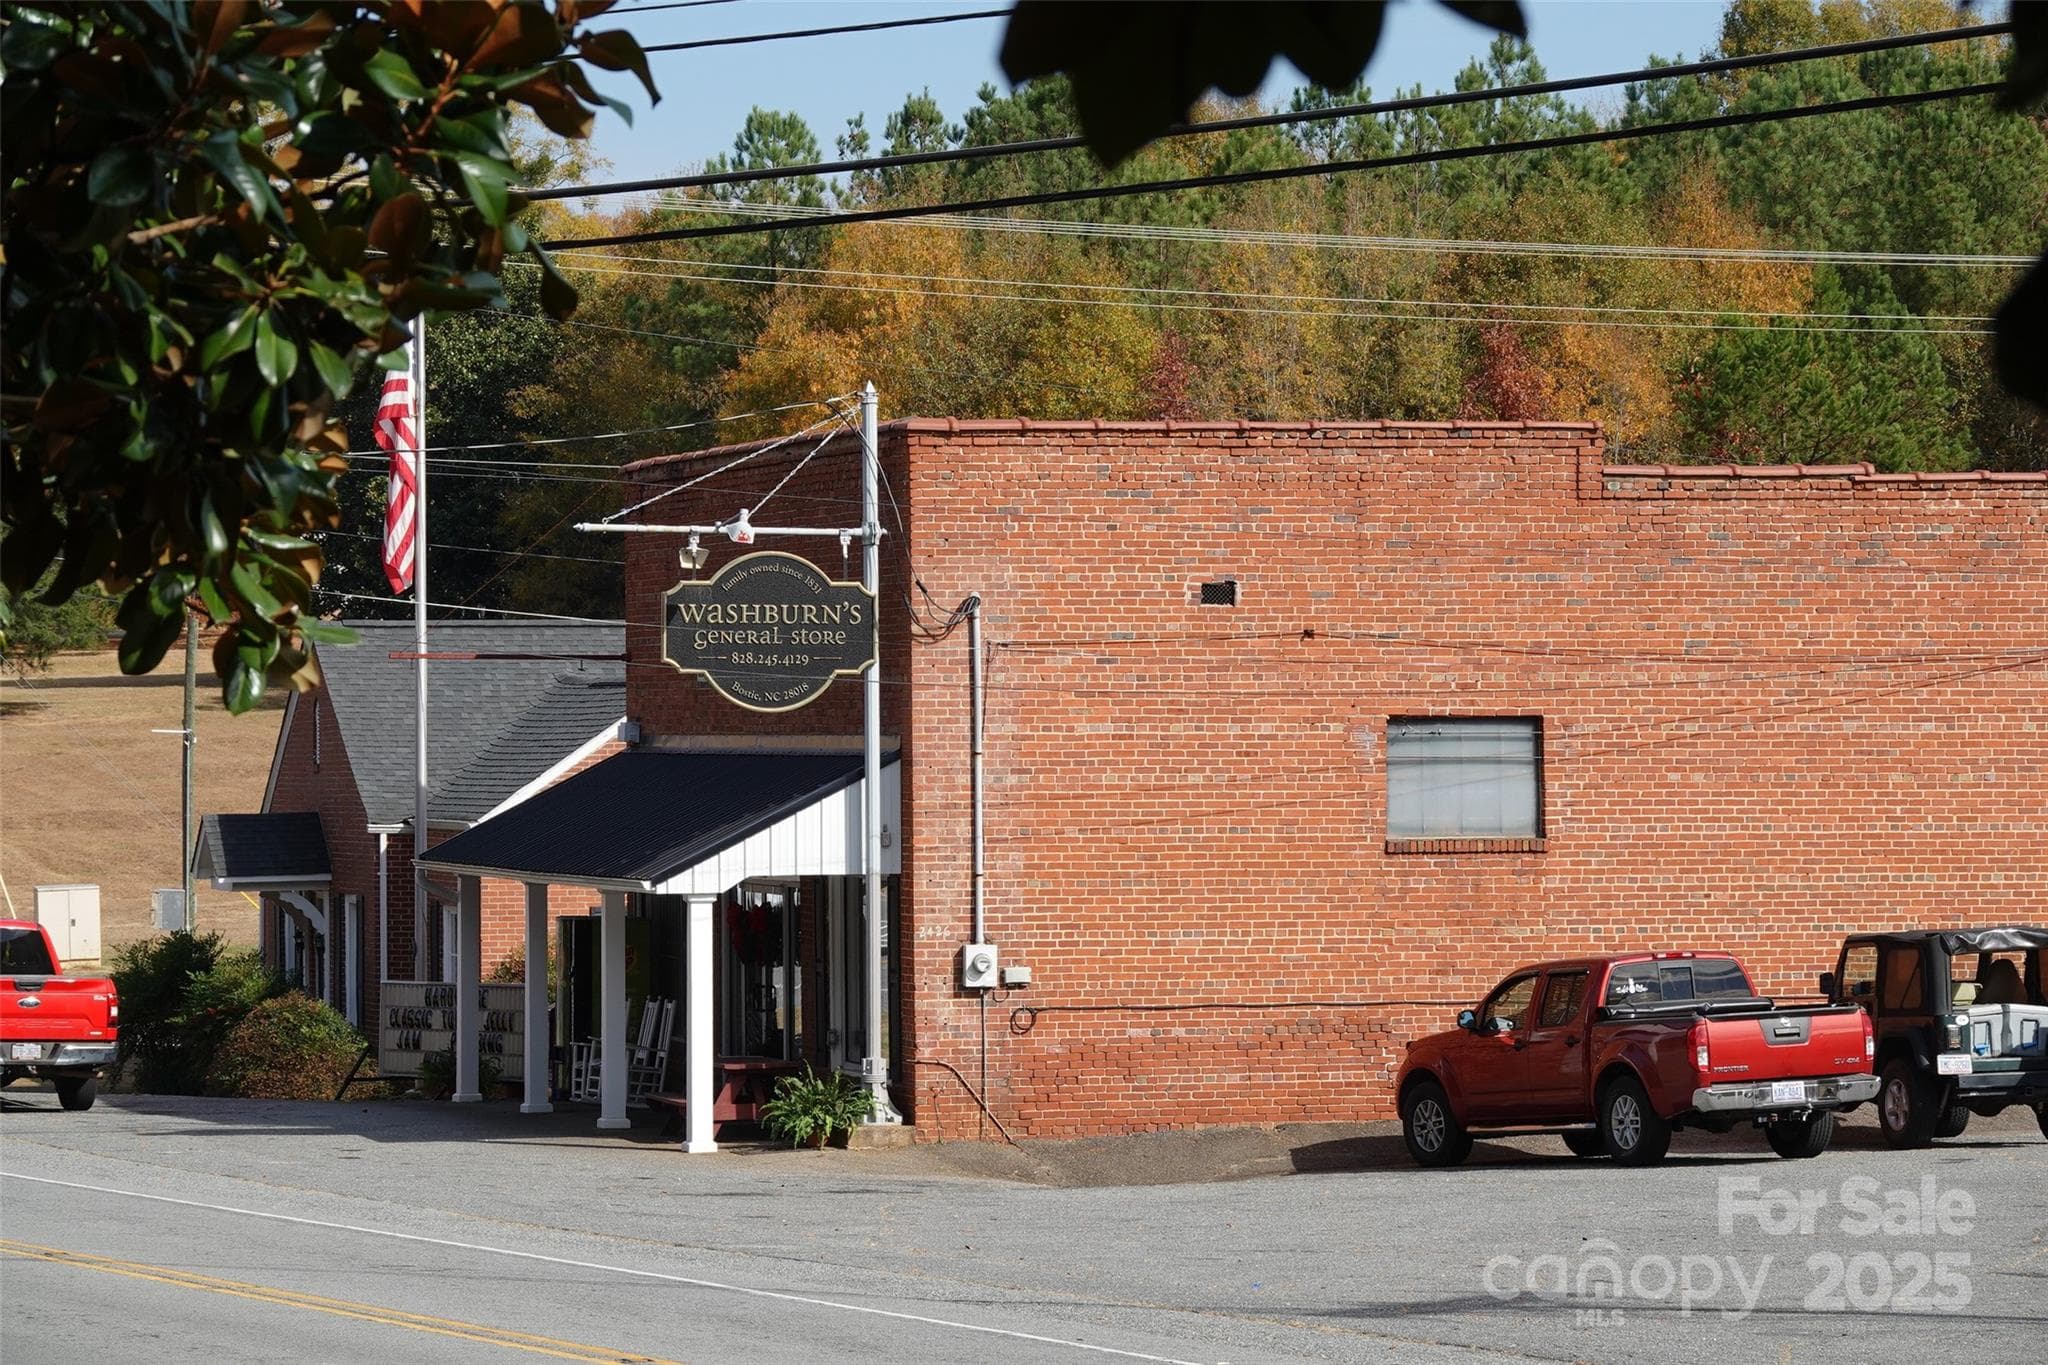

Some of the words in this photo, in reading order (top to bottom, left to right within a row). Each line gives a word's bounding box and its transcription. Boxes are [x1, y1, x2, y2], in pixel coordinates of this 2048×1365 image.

[721, 569, 748, 592] family
[749, 563, 779, 576] owned
[781, 564, 804, 580] since
[804, 575, 823, 594] 1831
[731, 651, 810, 666] 828.245.4129
[731, 680, 762, 702] Bostic,
[764, 691, 781, 702] NC
[782, 682, 810, 700] 28018
[424, 988, 489, 1009] HARDE
[389, 1008, 433, 1030] CLASSIC
